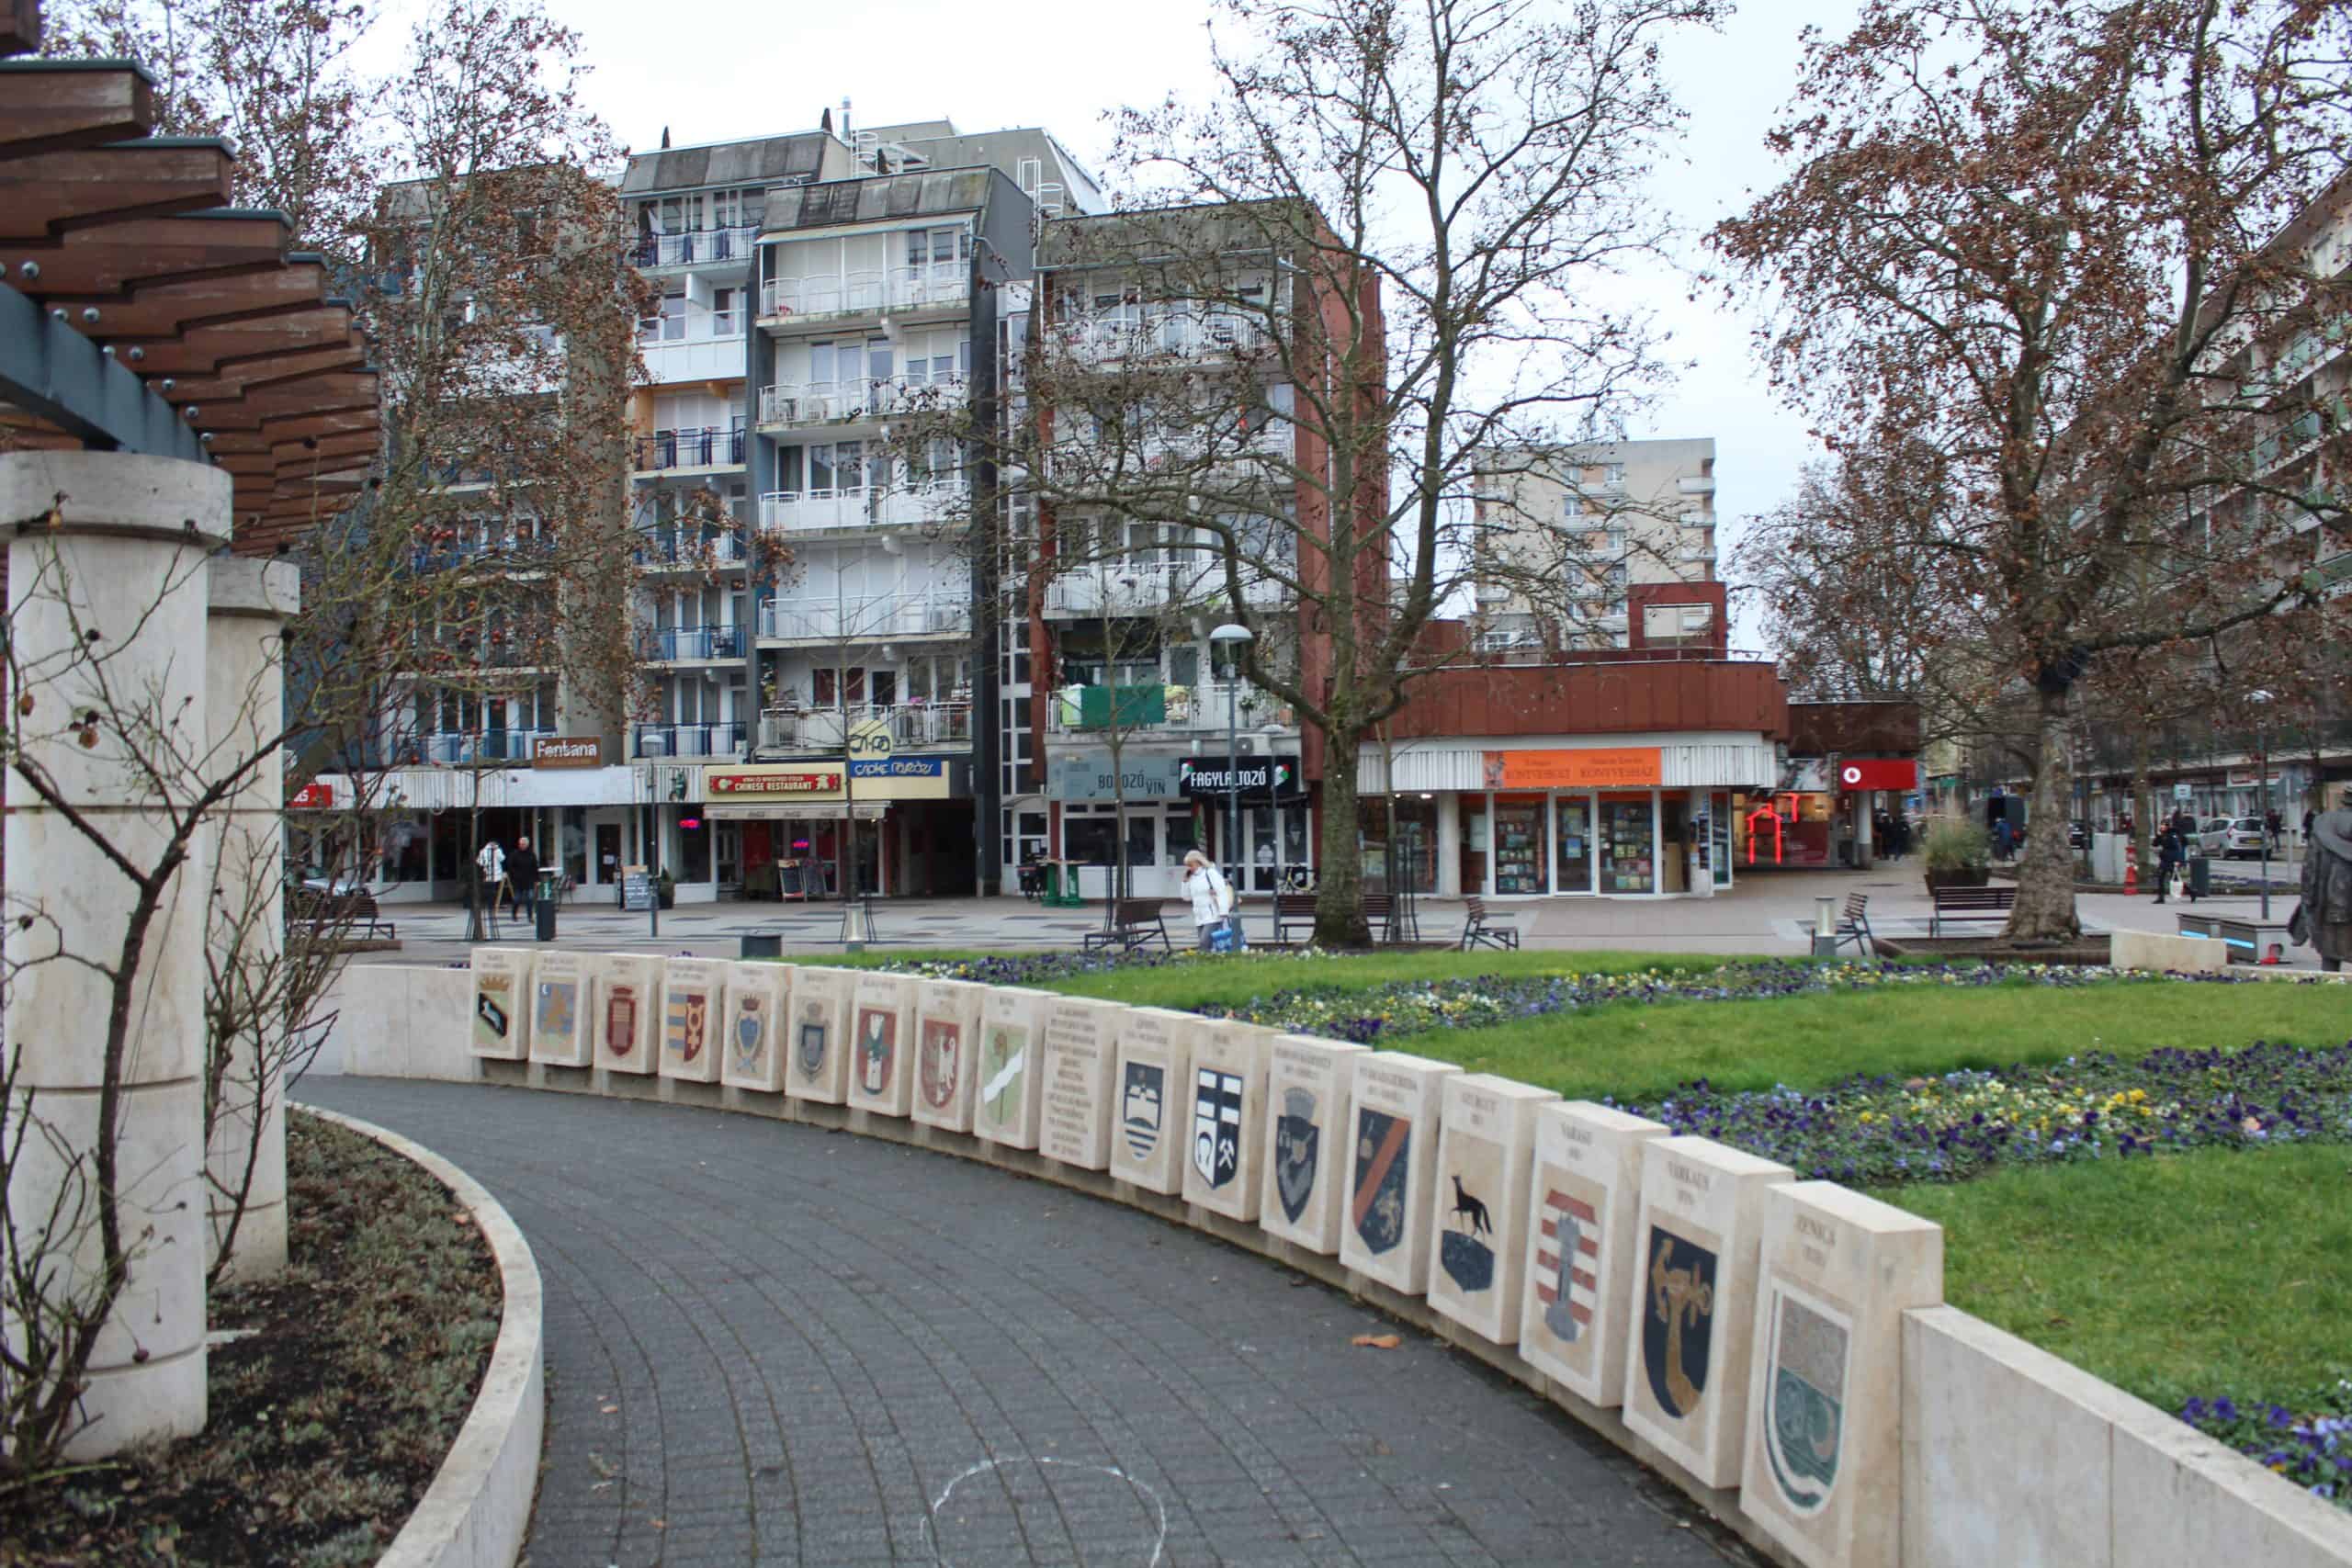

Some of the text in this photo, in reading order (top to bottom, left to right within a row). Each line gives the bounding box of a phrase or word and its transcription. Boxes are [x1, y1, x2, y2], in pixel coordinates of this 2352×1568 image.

[735, 779, 813, 792] CHINESE RESTAURANT
[1098, 768, 1167, 795] BOOZÓ VIN
